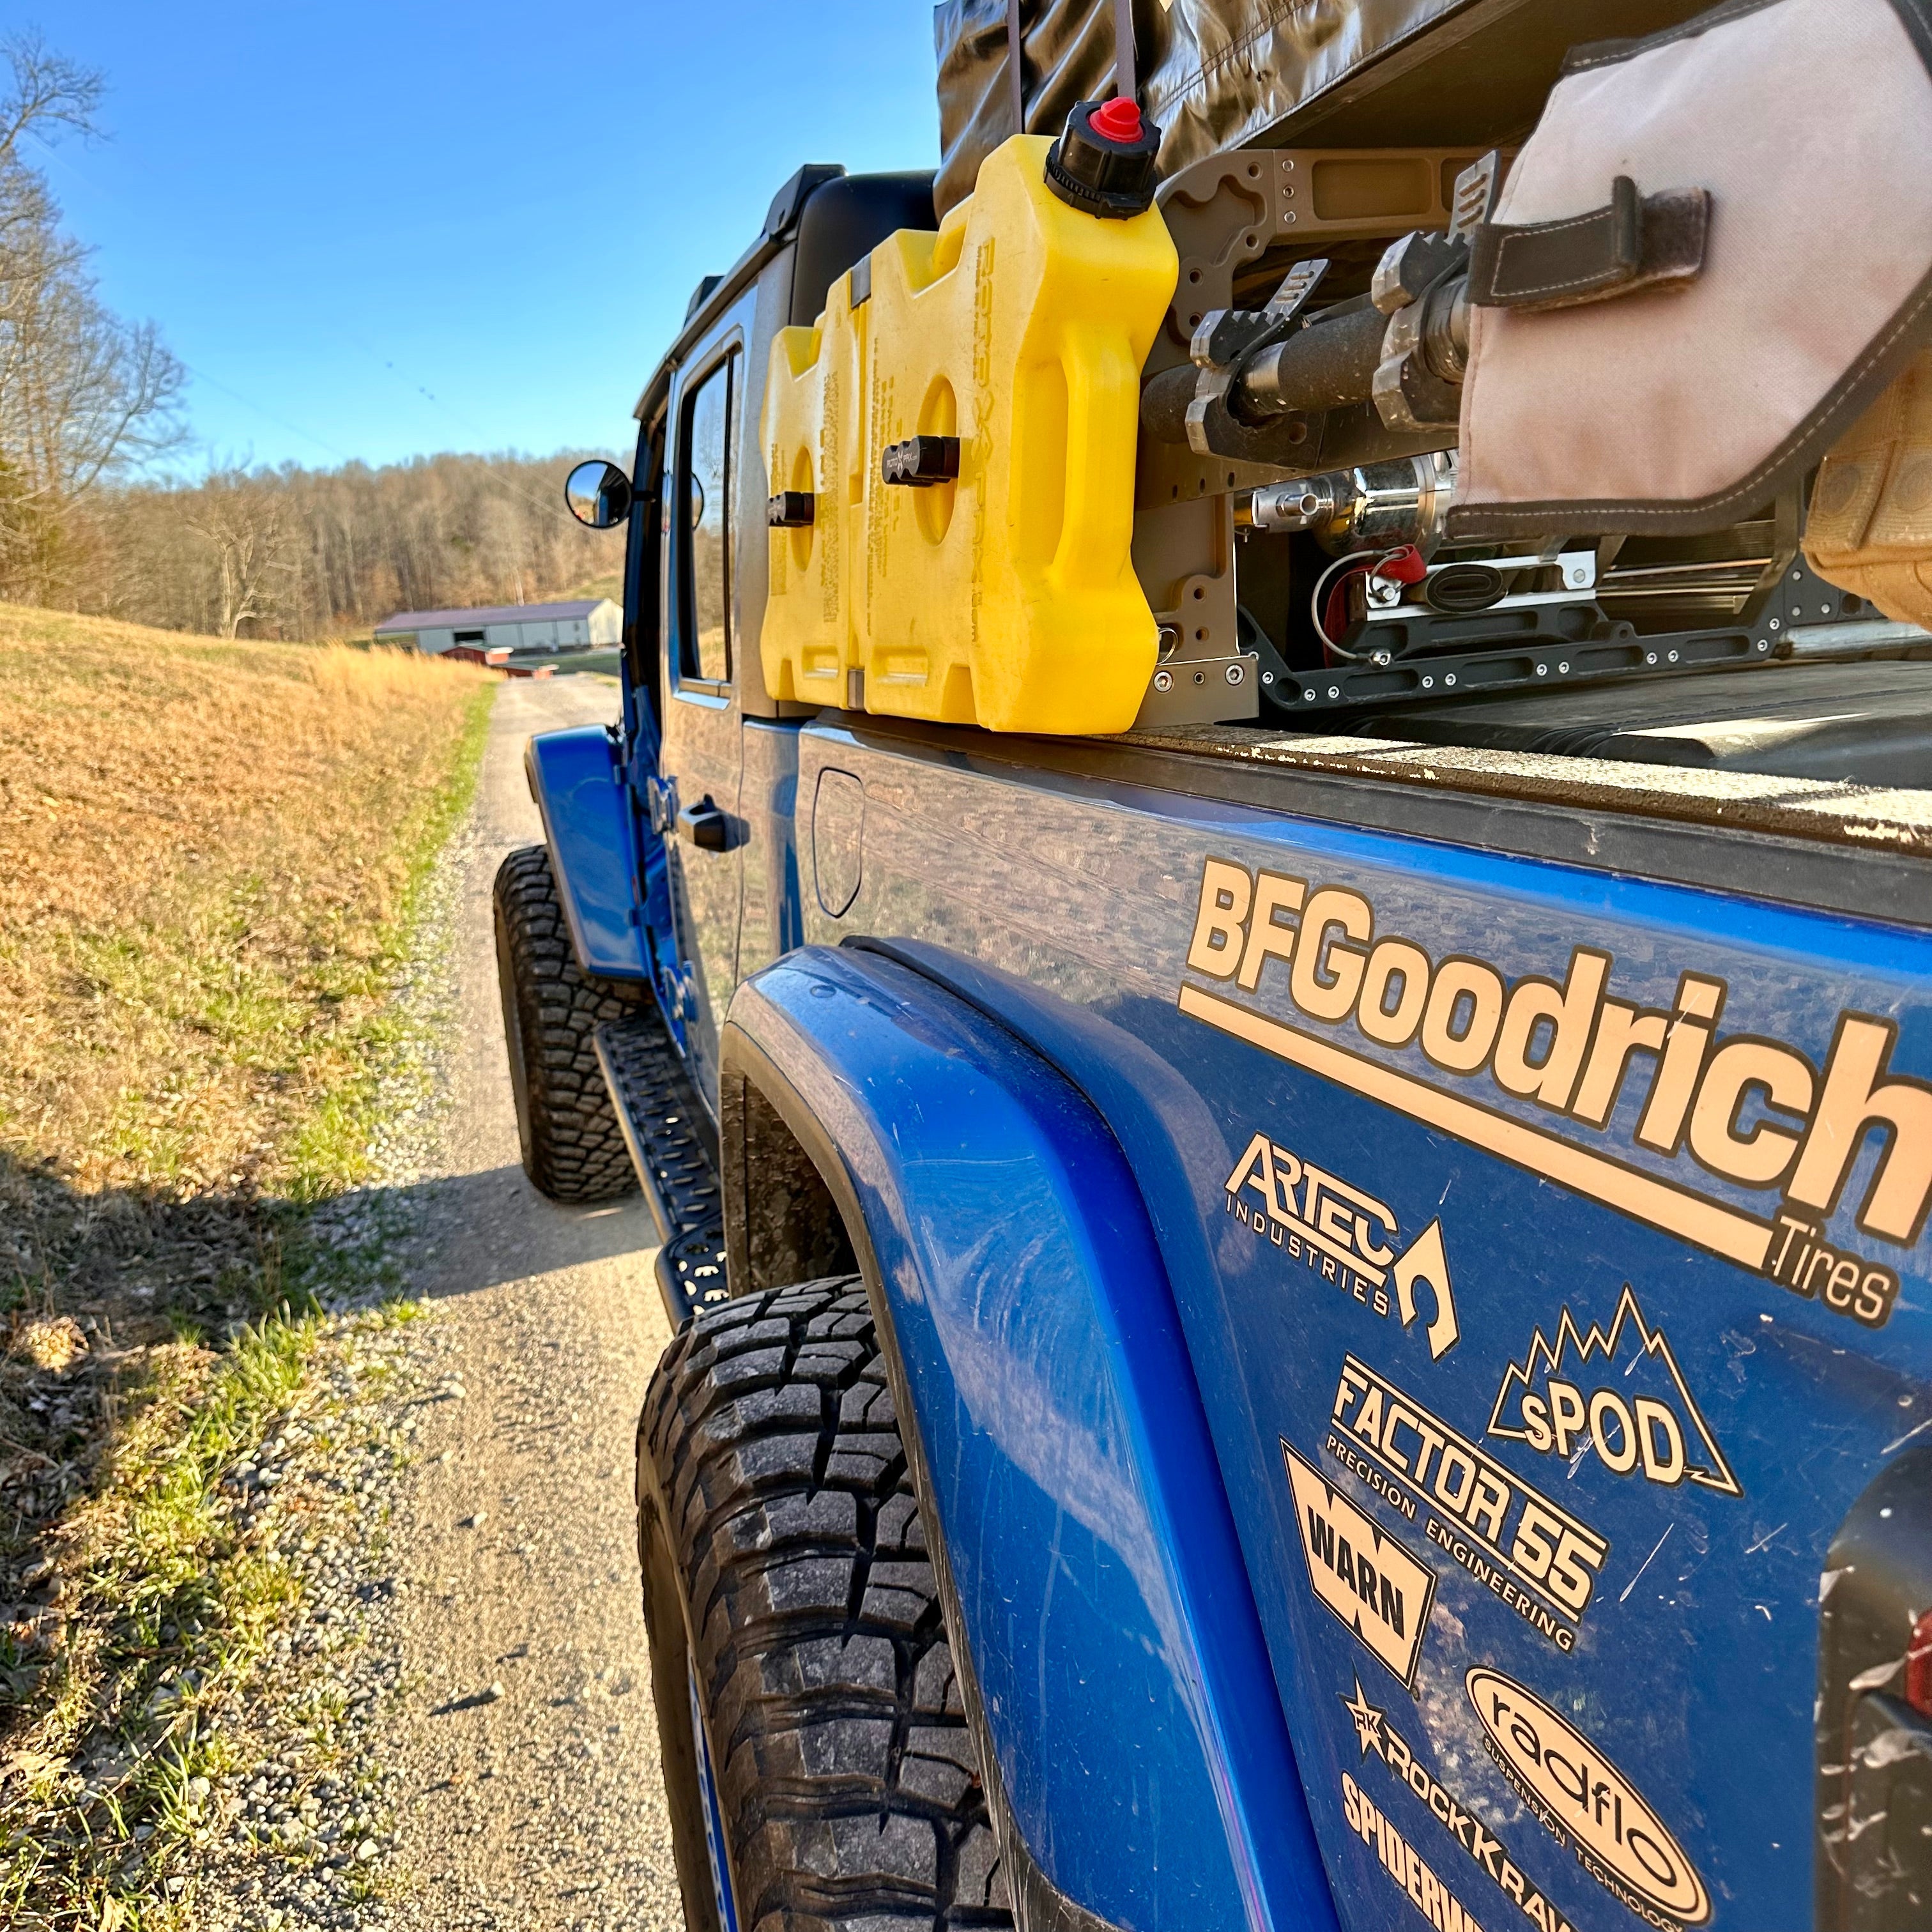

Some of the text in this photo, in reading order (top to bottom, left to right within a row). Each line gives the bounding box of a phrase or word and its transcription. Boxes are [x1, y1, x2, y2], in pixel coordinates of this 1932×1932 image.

[1187, 858, 1932, 1239] BFGoodrich
[1225, 1133, 1399, 1273] ARTEC
[1226, 1193, 1389, 1316] INDUSTRIES
[1773, 1215, 1890, 1319] Tires
[1332, 1365, 1602, 1610] FACTOR 55
[1521, 1380, 1686, 1484] sPOD
[1307, 1504, 1405, 1641] WARN
[1326, 1434, 1574, 1652] PRECISION ENGINEERING
[1342, 1772, 1484, 1932] SPIDERW
[1484, 1737, 1566, 1847] SUSPENSION
[1492, 1692, 1678, 1887] radflo
